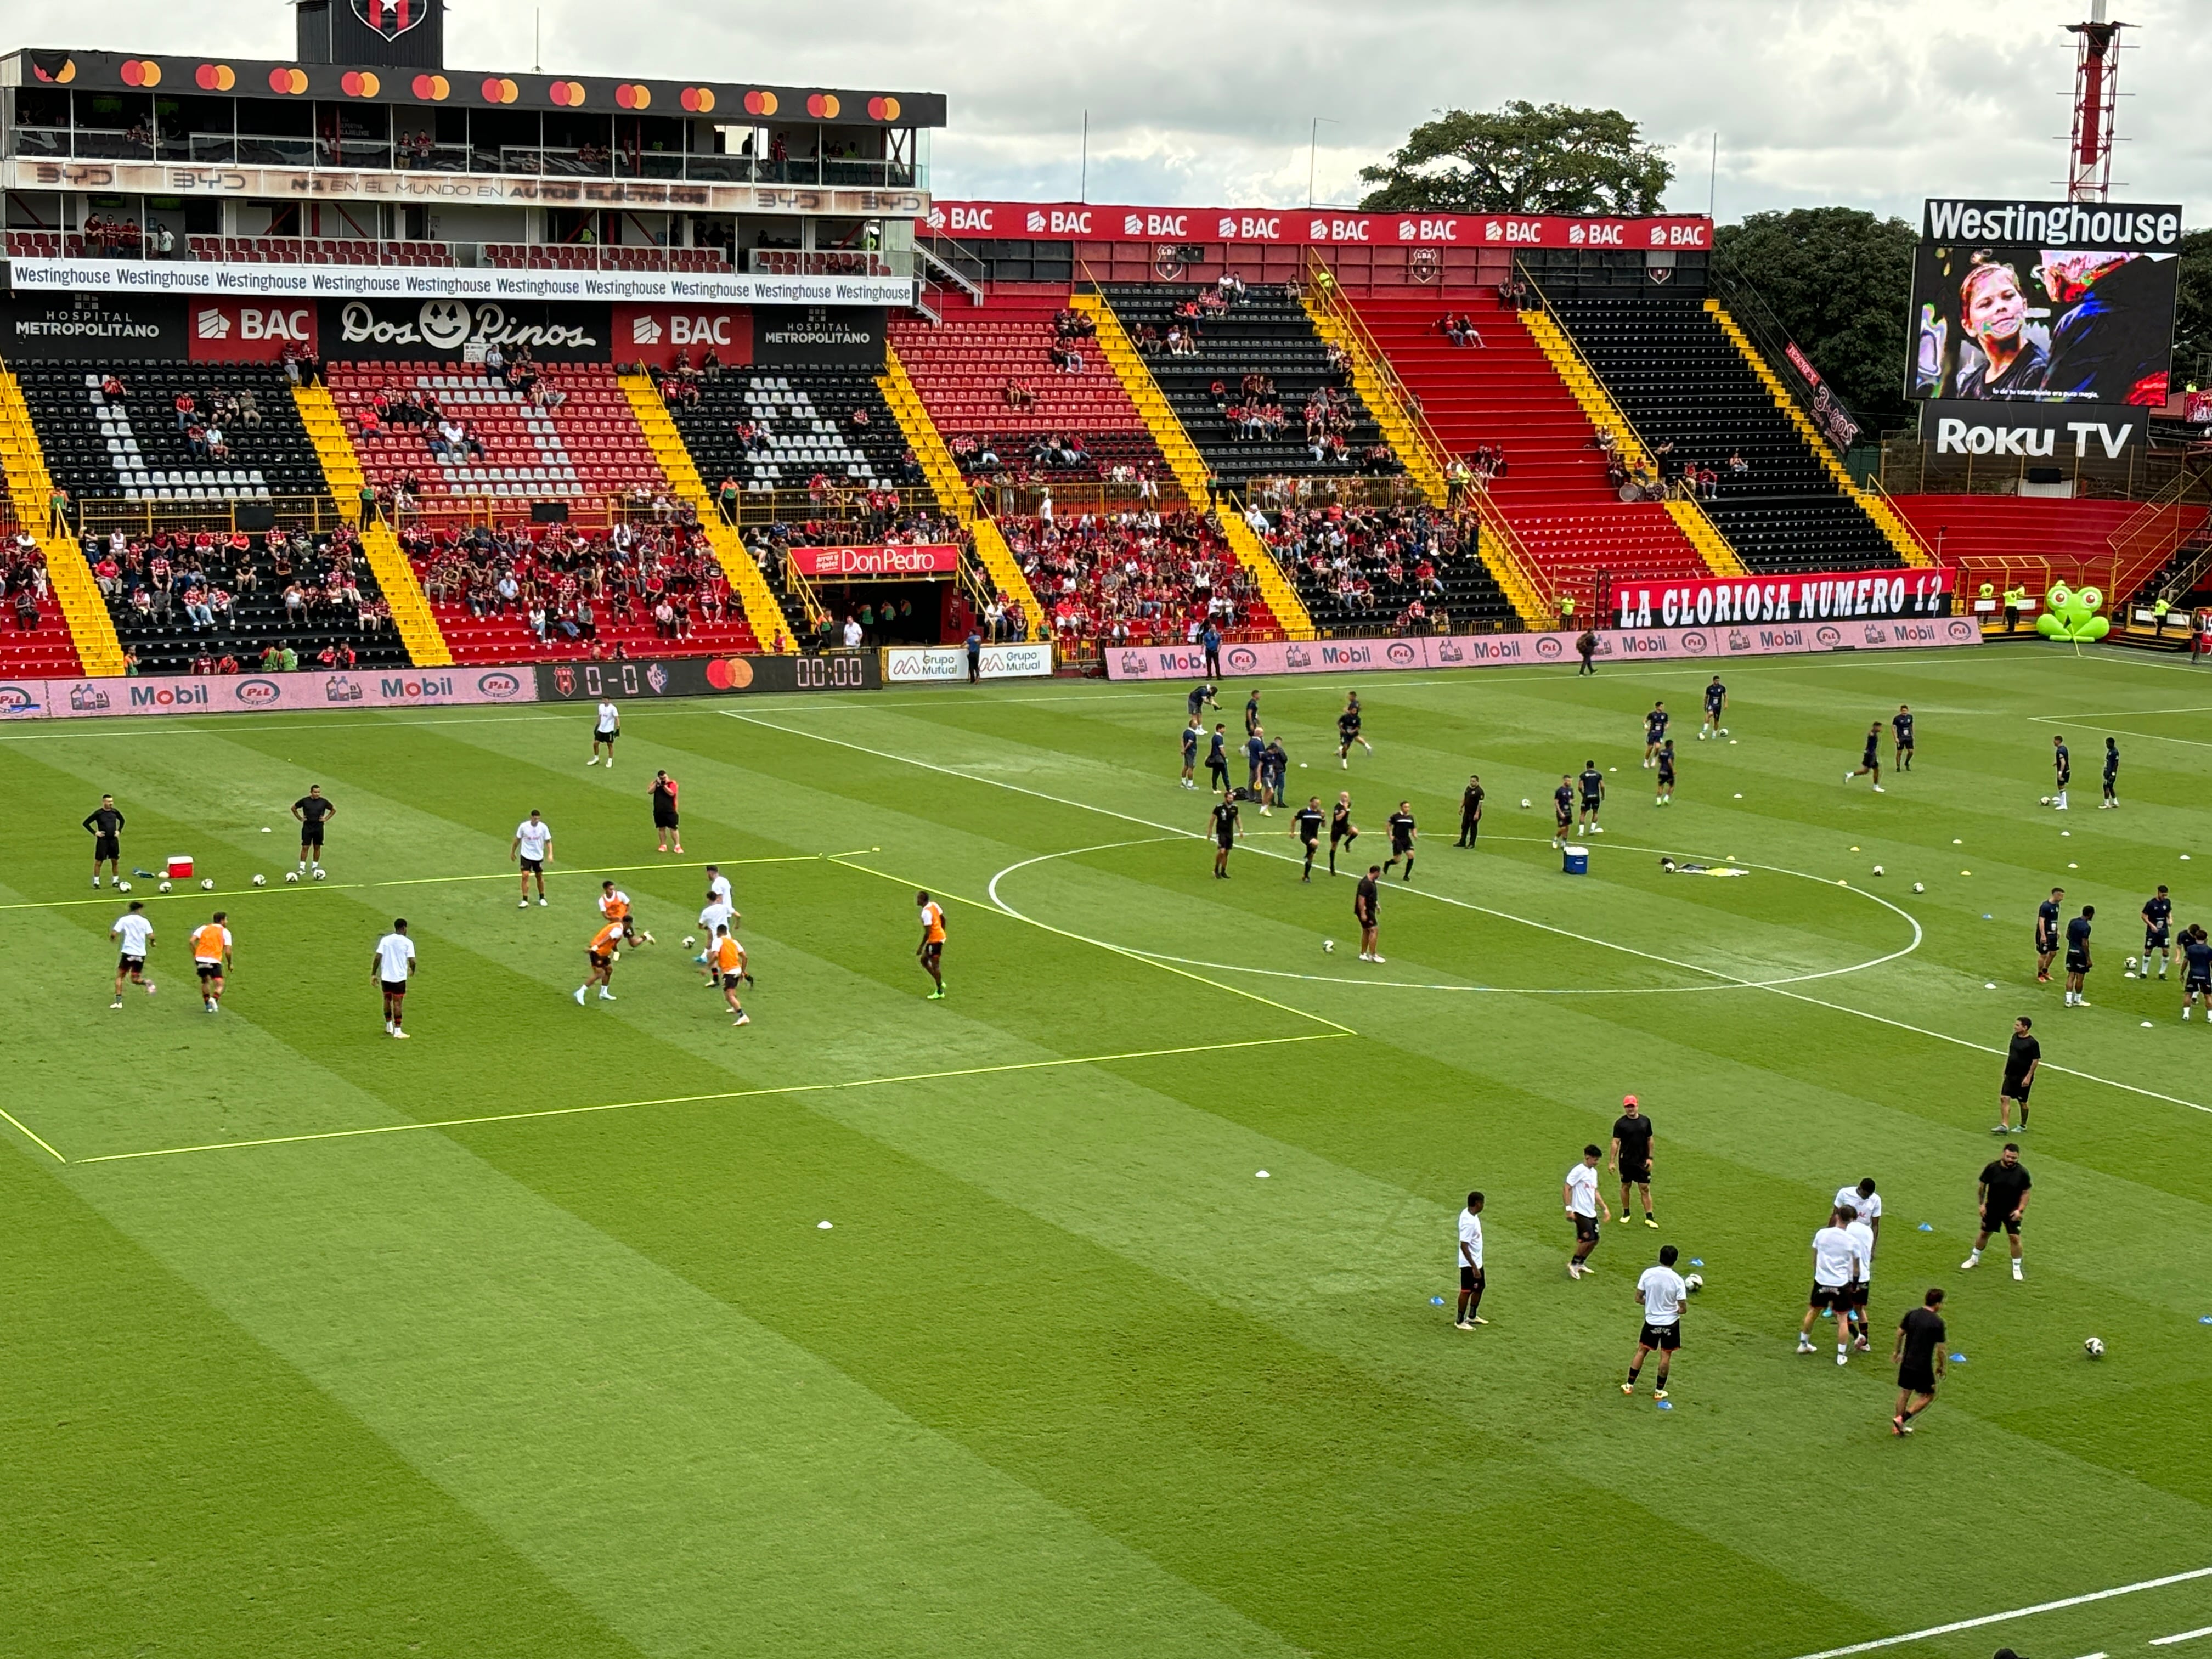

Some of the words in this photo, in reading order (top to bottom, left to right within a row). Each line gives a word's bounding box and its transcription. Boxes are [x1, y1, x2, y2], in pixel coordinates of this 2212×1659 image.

[330, 181, 359, 193] EN
[365, 182, 388, 193] EL
[394, 183, 471, 195] MUNDO
[477, 185, 503, 197] EN
[510, 187, 579, 200] AUTOS
[950, 207, 994, 230] BAC
[1050, 211, 1092, 234] BAC
[1147, 215, 1188, 237] BAC
[1240, 217, 1280, 239] BAC
[1929, 201, 2177, 245] Westinghouse
[1331, 219, 1369, 241] BAC
[1419, 219, 1457, 241] BAC
[1505, 222, 1542, 243] BAC
[1588, 224, 1624, 245] BAC
[1669, 225, 1704, 246] BAC
[15, 266, 110, 285] Westinghouse
[116, 268, 209, 288] Westinghouse
[216, 272, 307, 291] Westinghouse
[312, 274, 400, 293] Westinghouse
[406, 276, 491, 295] Westinghouse
[496, 278, 579, 296] Westinghouse
[585, 279, 666, 297] Westinghouse
[672, 281, 749, 299] Westinghouse
[755, 283, 831, 300] Westinghouse
[836, 284, 910, 302] Westinghouse
[46, 311, 132, 323] HOSPITAL
[240, 309, 309, 340] BAC
[342, 301, 422, 344] Dos
[470, 303, 597, 347] Pinos
[15, 321, 160, 338] METROPOLITANO
[671, 316, 731, 345] BAC
[787, 323, 850, 331] HOSPITAL
[765, 332, 870, 344] METROPOLITANO
[1936, 417, 2056, 457] Roku
[2067, 422, 2134, 459] TV
[1620, 590, 1652, 628] LA
[1662, 583, 1790, 627] GLORIOSA
[1799, 577, 1905, 619] NUMERO
[1915, 575, 1943, 611] 12
[1759, 630, 1802, 647] Mobil
[1894, 625, 1935, 641] Mobil
[1474, 640, 1521, 658] Mobil
[1622, 635, 1667, 653] Mobil
[923, 654, 955, 665] Grupo
[1006, 651, 1037, 662] Grupo
[1160, 653, 1206, 670] Mob
[1322, 646, 1371, 664] Mobil
[1394, 650, 1410, 658] P&L
[797, 658, 863, 687] 00:00
[922, 665, 957, 675] Mutual
[1006, 661, 1040, 671] Mutual
[247, 688, 270, 696] P&L
[381, 676, 453, 697] Mobil
[488, 681, 511, 689] P&L
[0, 696, 22, 704] P&L
[131, 684, 208, 706] Mobil
